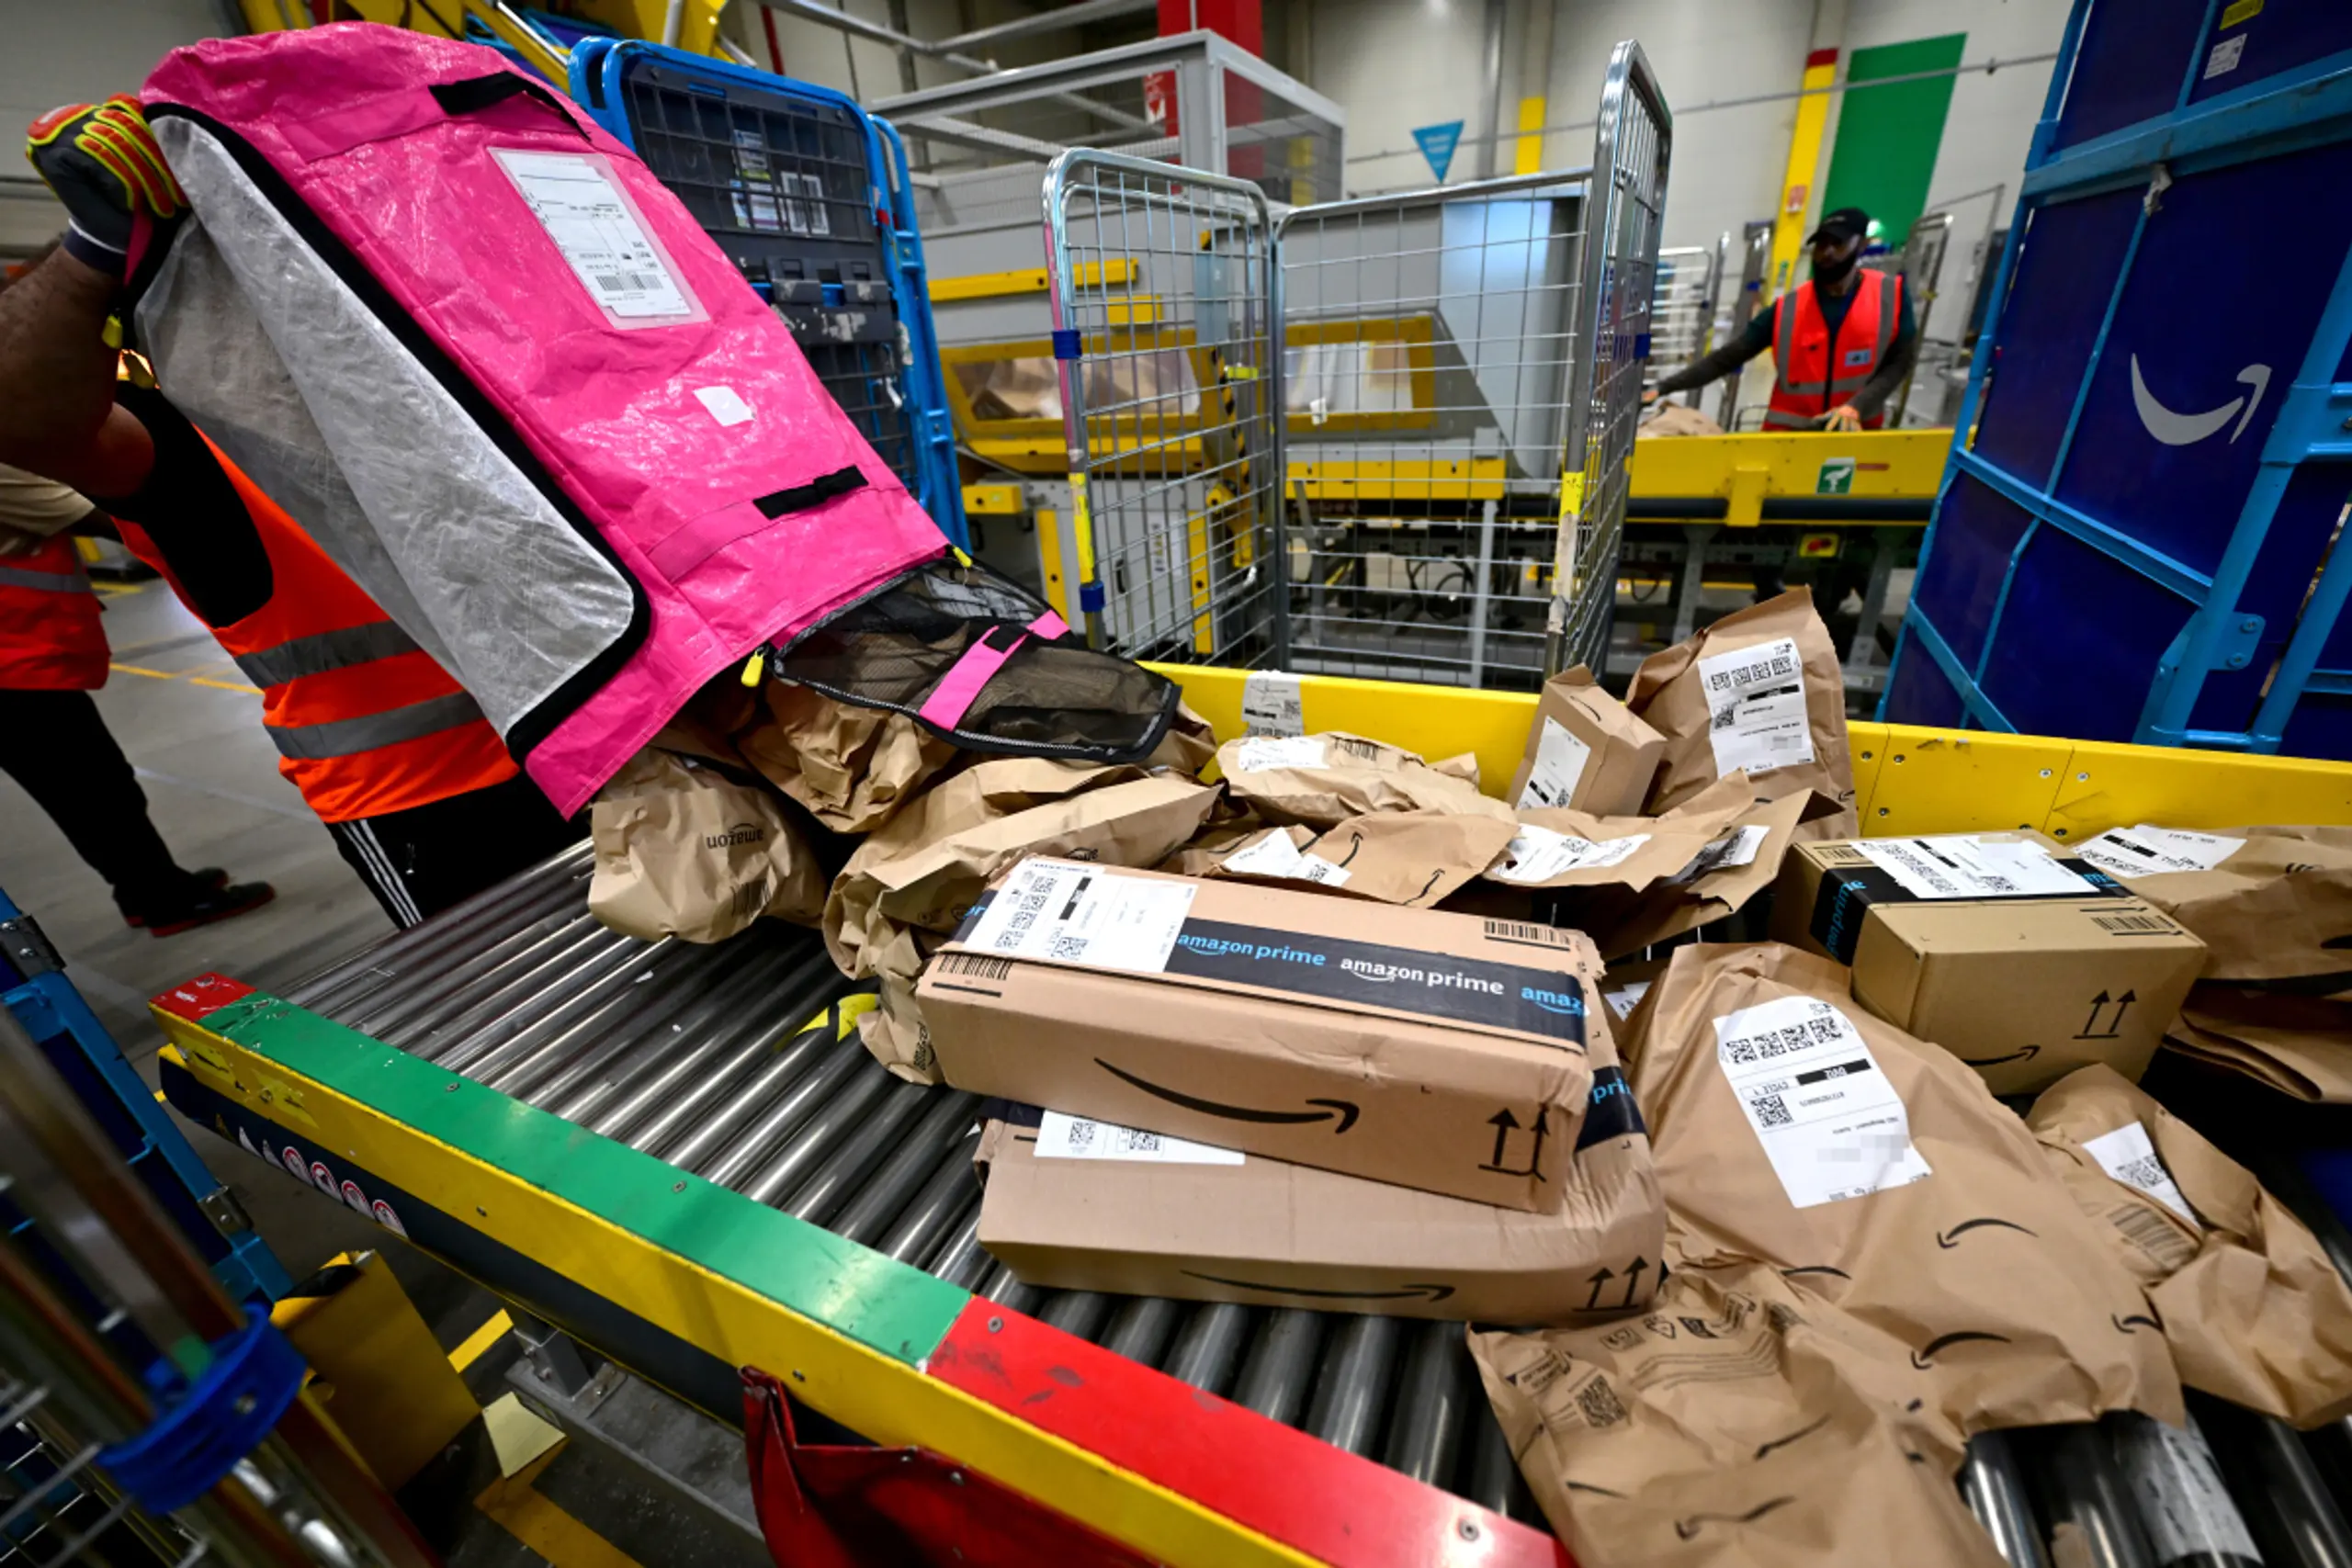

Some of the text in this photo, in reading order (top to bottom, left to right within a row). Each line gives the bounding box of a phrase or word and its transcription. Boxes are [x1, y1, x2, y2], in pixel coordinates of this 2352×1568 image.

[707, 829, 764, 850] amazon
[1177, 933, 1254, 955] amazon
[1254, 944, 1327, 965] prime
[1340, 957, 1424, 982] amazon
[1427, 971, 1505, 995] prime
